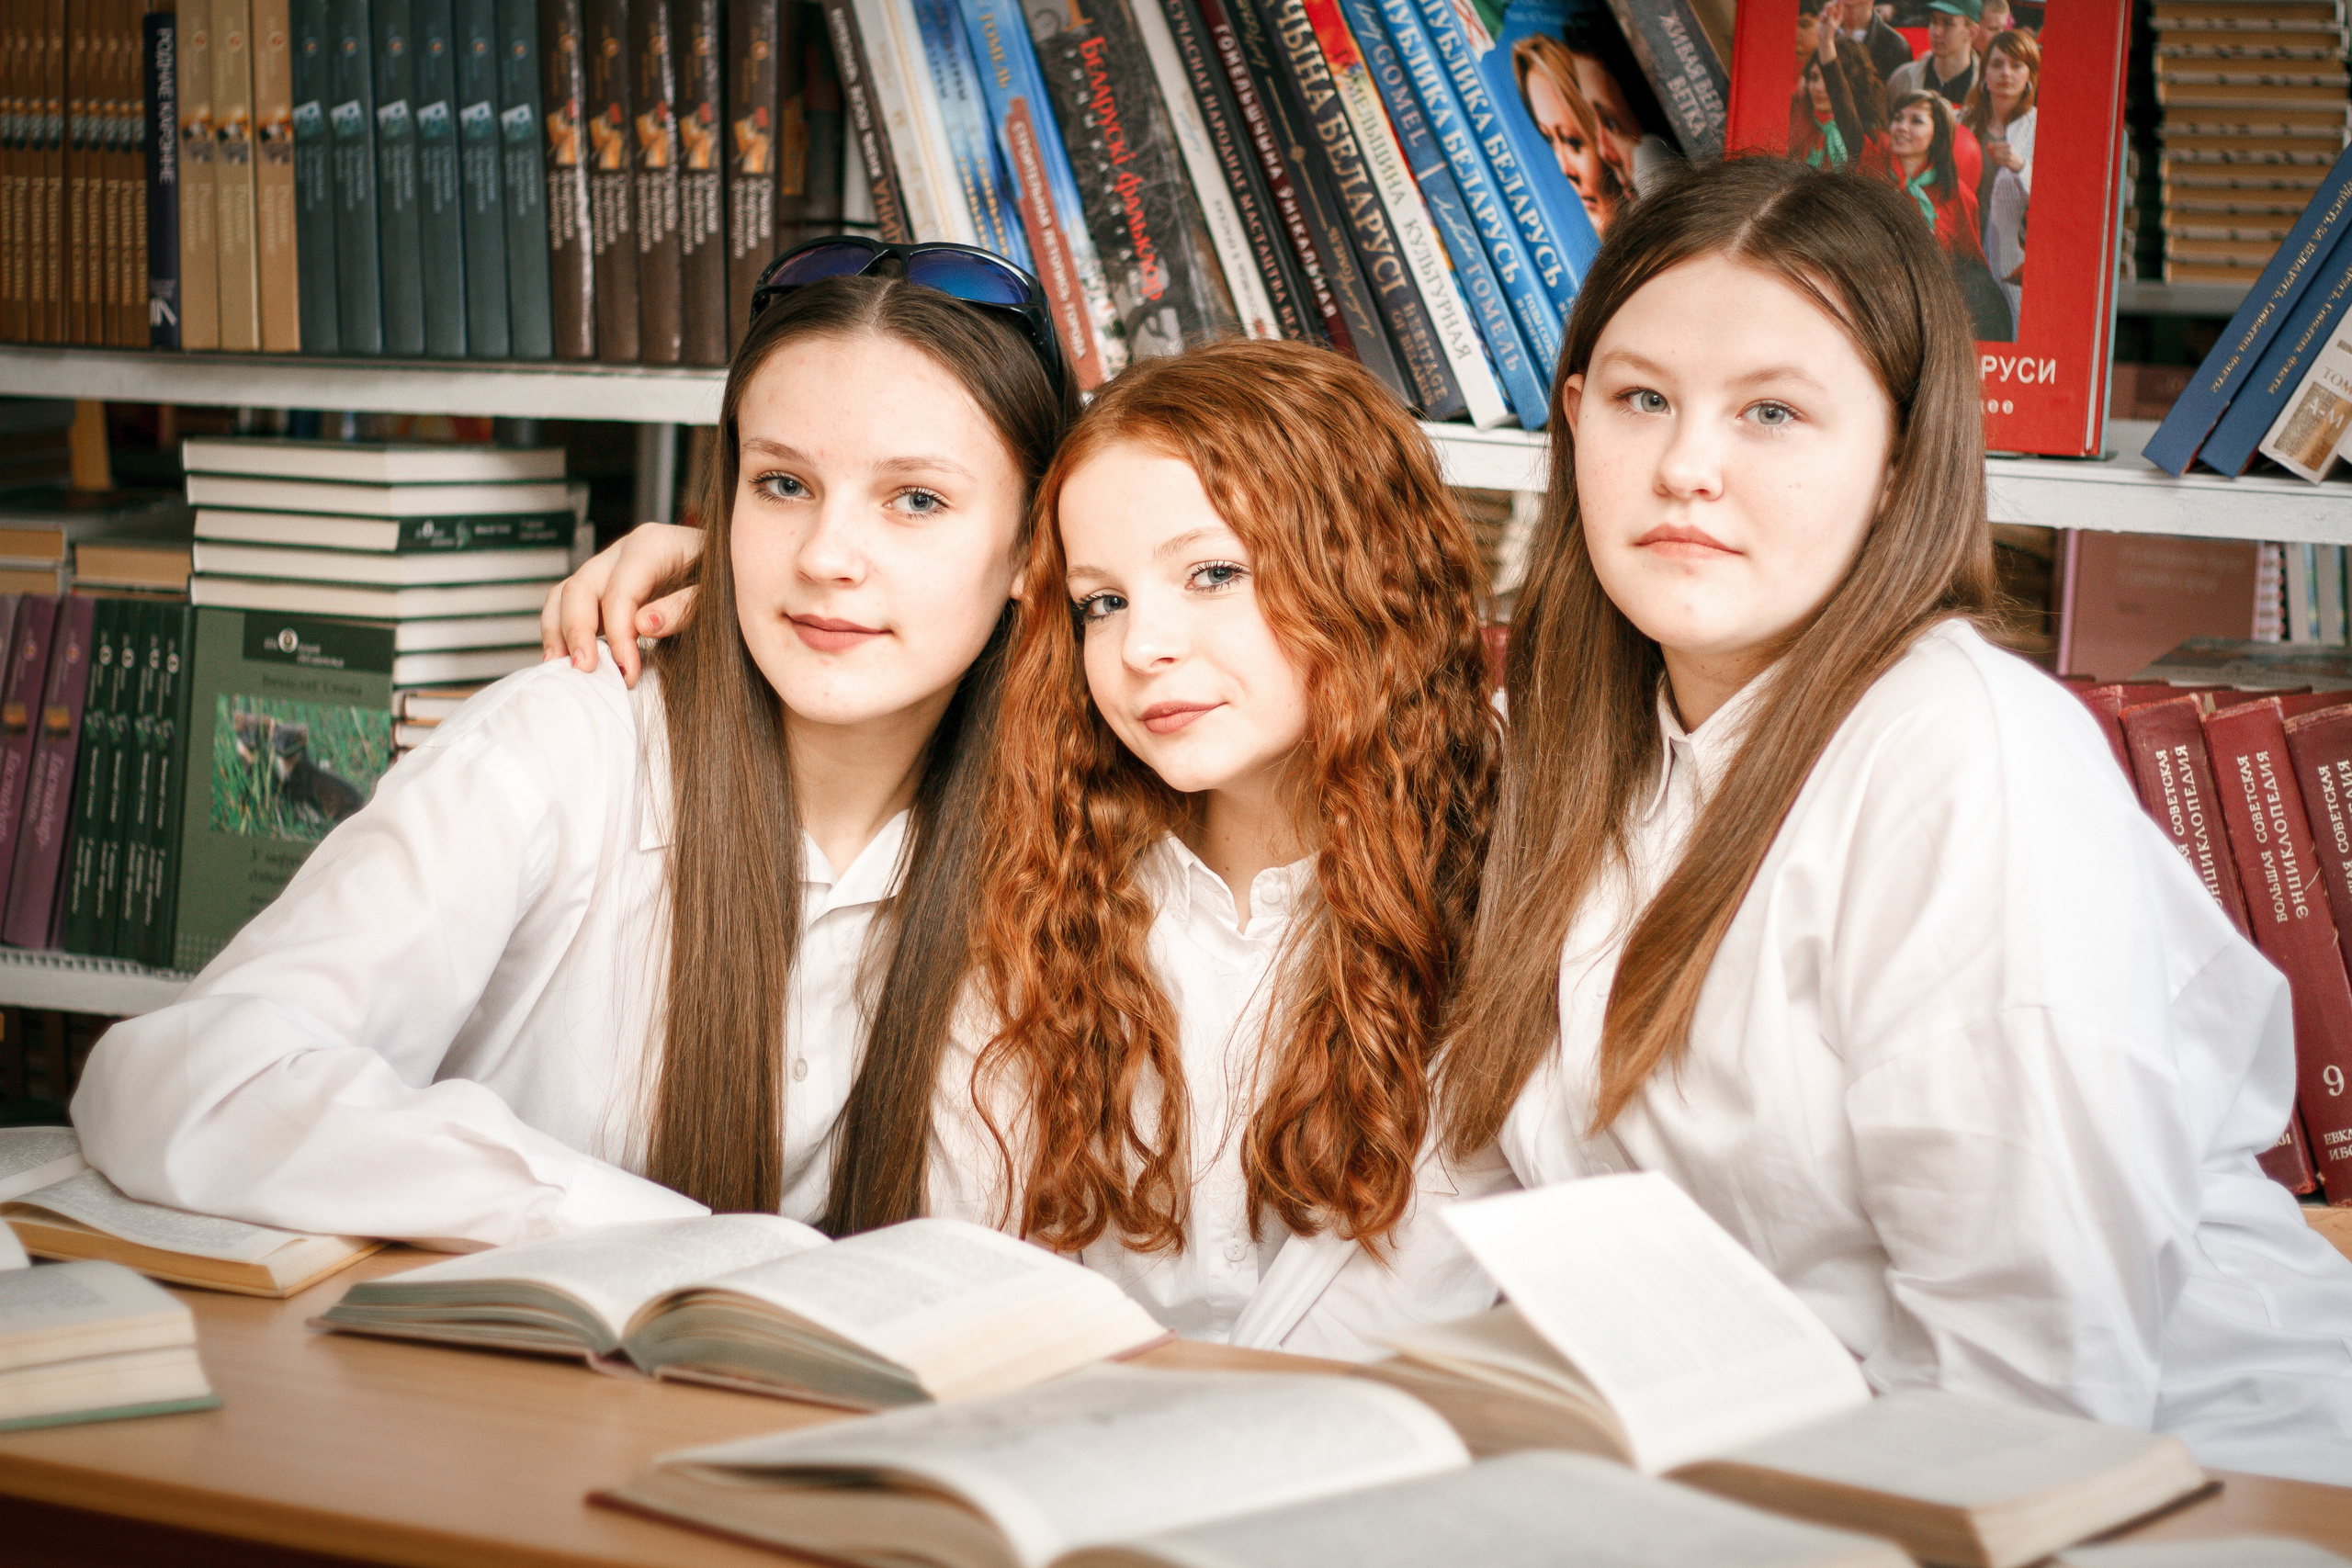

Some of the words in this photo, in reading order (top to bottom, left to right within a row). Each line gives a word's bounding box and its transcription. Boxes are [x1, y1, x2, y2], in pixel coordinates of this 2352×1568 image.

[979, 12, 1012, 90] ГОМЕЛЬ
[1373, 44, 1429, 148] GOMEL
[1658, 9, 1707, 82] ЖИВАЯ
[1692, 77, 1727, 128] ВЕРА
[1264, 0, 1337, 117] ЧЫНА
[1315, 109, 1408, 299] БЕЛАРУСІ
[1381, 0, 1454, 130] УБЛИКА
[1442, 129, 1521, 285] БЕЛАРУСЬ
[1420, 0, 1495, 134] УБЛИКА
[1482, 131, 1563, 288] БЕЛАРУСЬ
[1666, 74, 1708, 139] ВЕТКА
[874, 176, 904, 245] ДИНА
[1202, 93, 1248, 191] НАРОДНАЕ
[1240, 193, 1287, 304] МАСТАЦТВА
[1280, 305, 1301, 339] БЕЛА
[1403, 217, 1473, 361] КУЛЬТУРНАЯ
[1465, 262, 1521, 372] ГОМЕЛЬ
[1400, 333, 1436, 408] BELARUS
[1402, 301, 1449, 402] HERITAGE
[1979, 354, 2056, 385] РУСИ
[2155, 749, 2185, 837] СОВЕТСКАЯ
[2236, 754, 2268, 844] СОВЕТСКАЯ
[2256, 750, 2309, 919] ЭНЦИКЛОПЕДИЯ
[2317, 764, 2350, 854] СОВЕТСКАЯ
[2260, 849, 2289, 924] БОЛЬШАЯ
[2323, 1064, 2346, 1097] 9
[2323, 1128, 2352, 1146] ЕВКЛ
